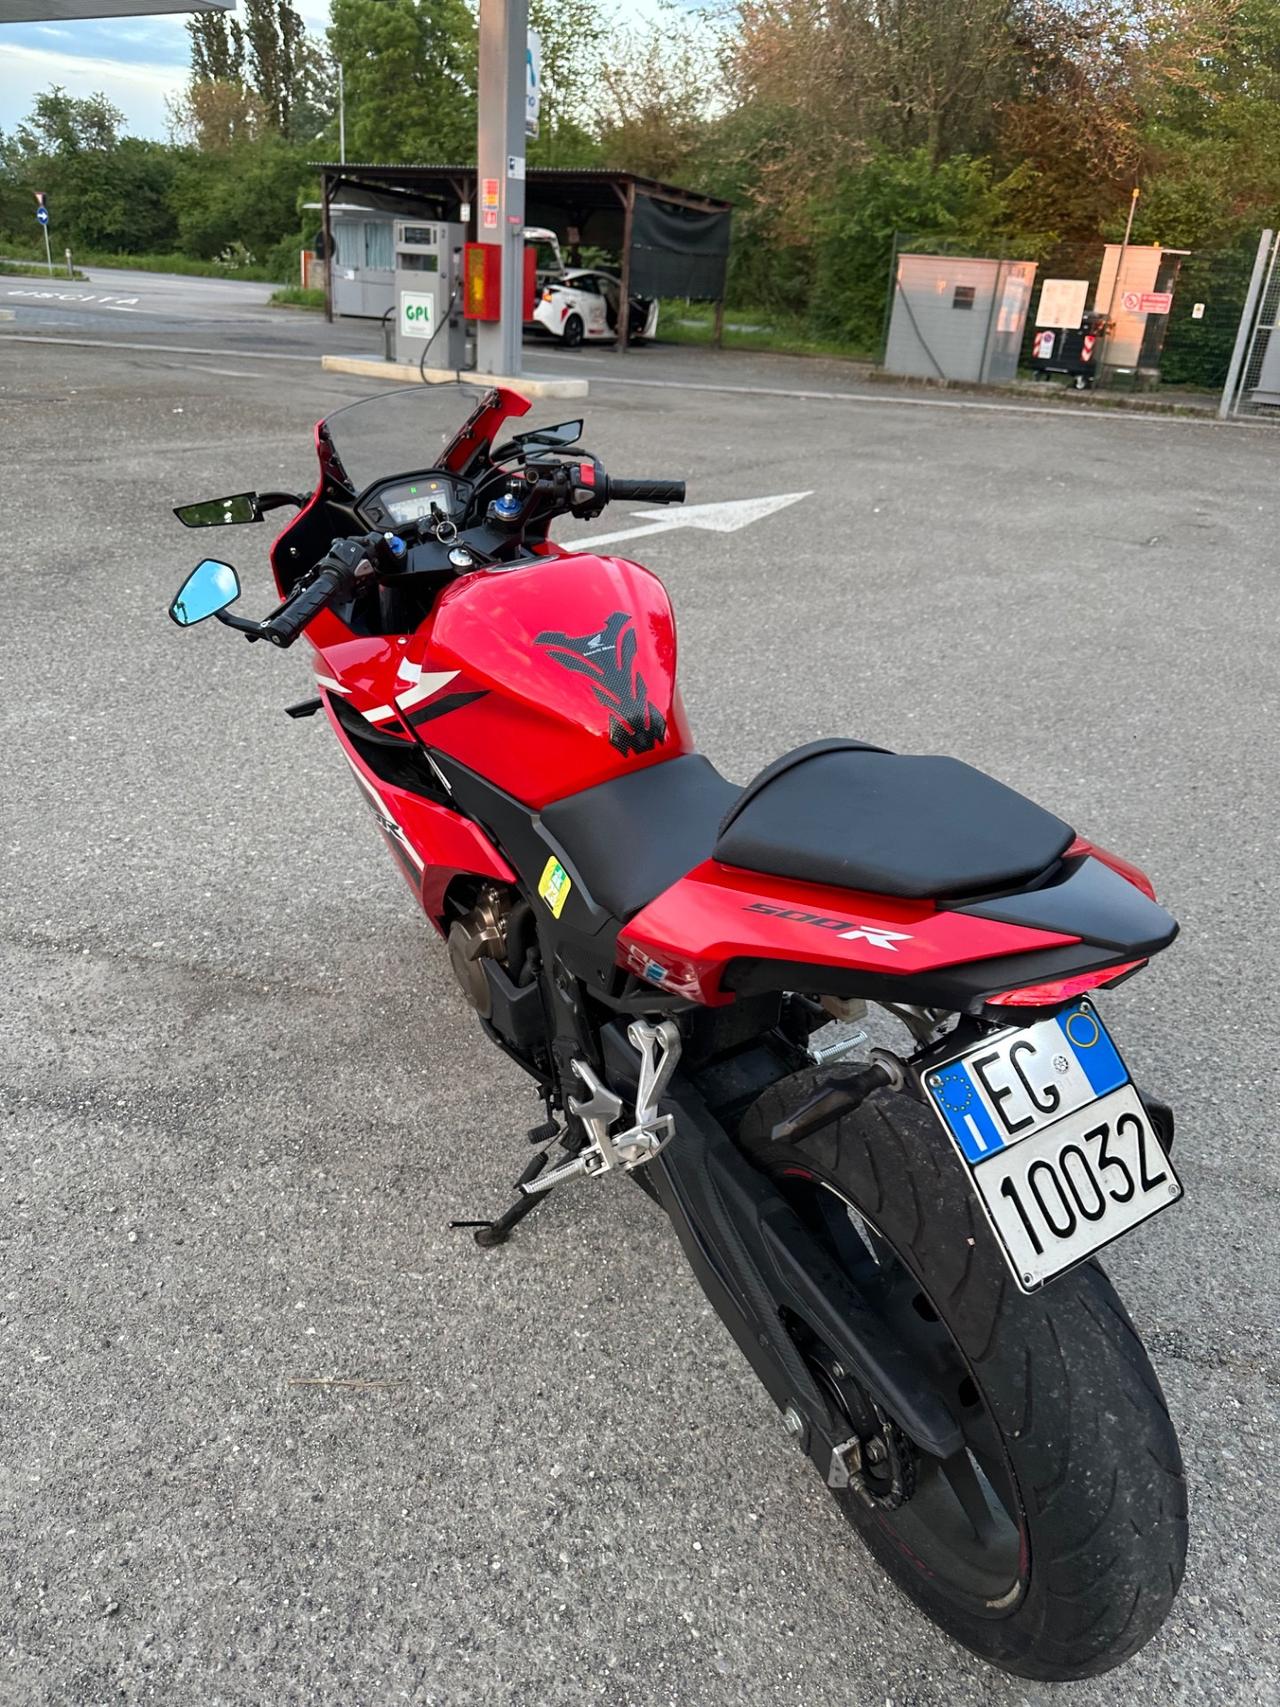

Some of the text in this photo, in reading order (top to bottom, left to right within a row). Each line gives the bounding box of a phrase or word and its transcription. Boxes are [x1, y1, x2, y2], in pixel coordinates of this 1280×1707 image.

[8, 290, 139, 305] USCITA
[972, 1040, 1060, 1135] EG
[963, 1113, 988, 1152] I
[1000, 1113, 1167, 1255] 10032
